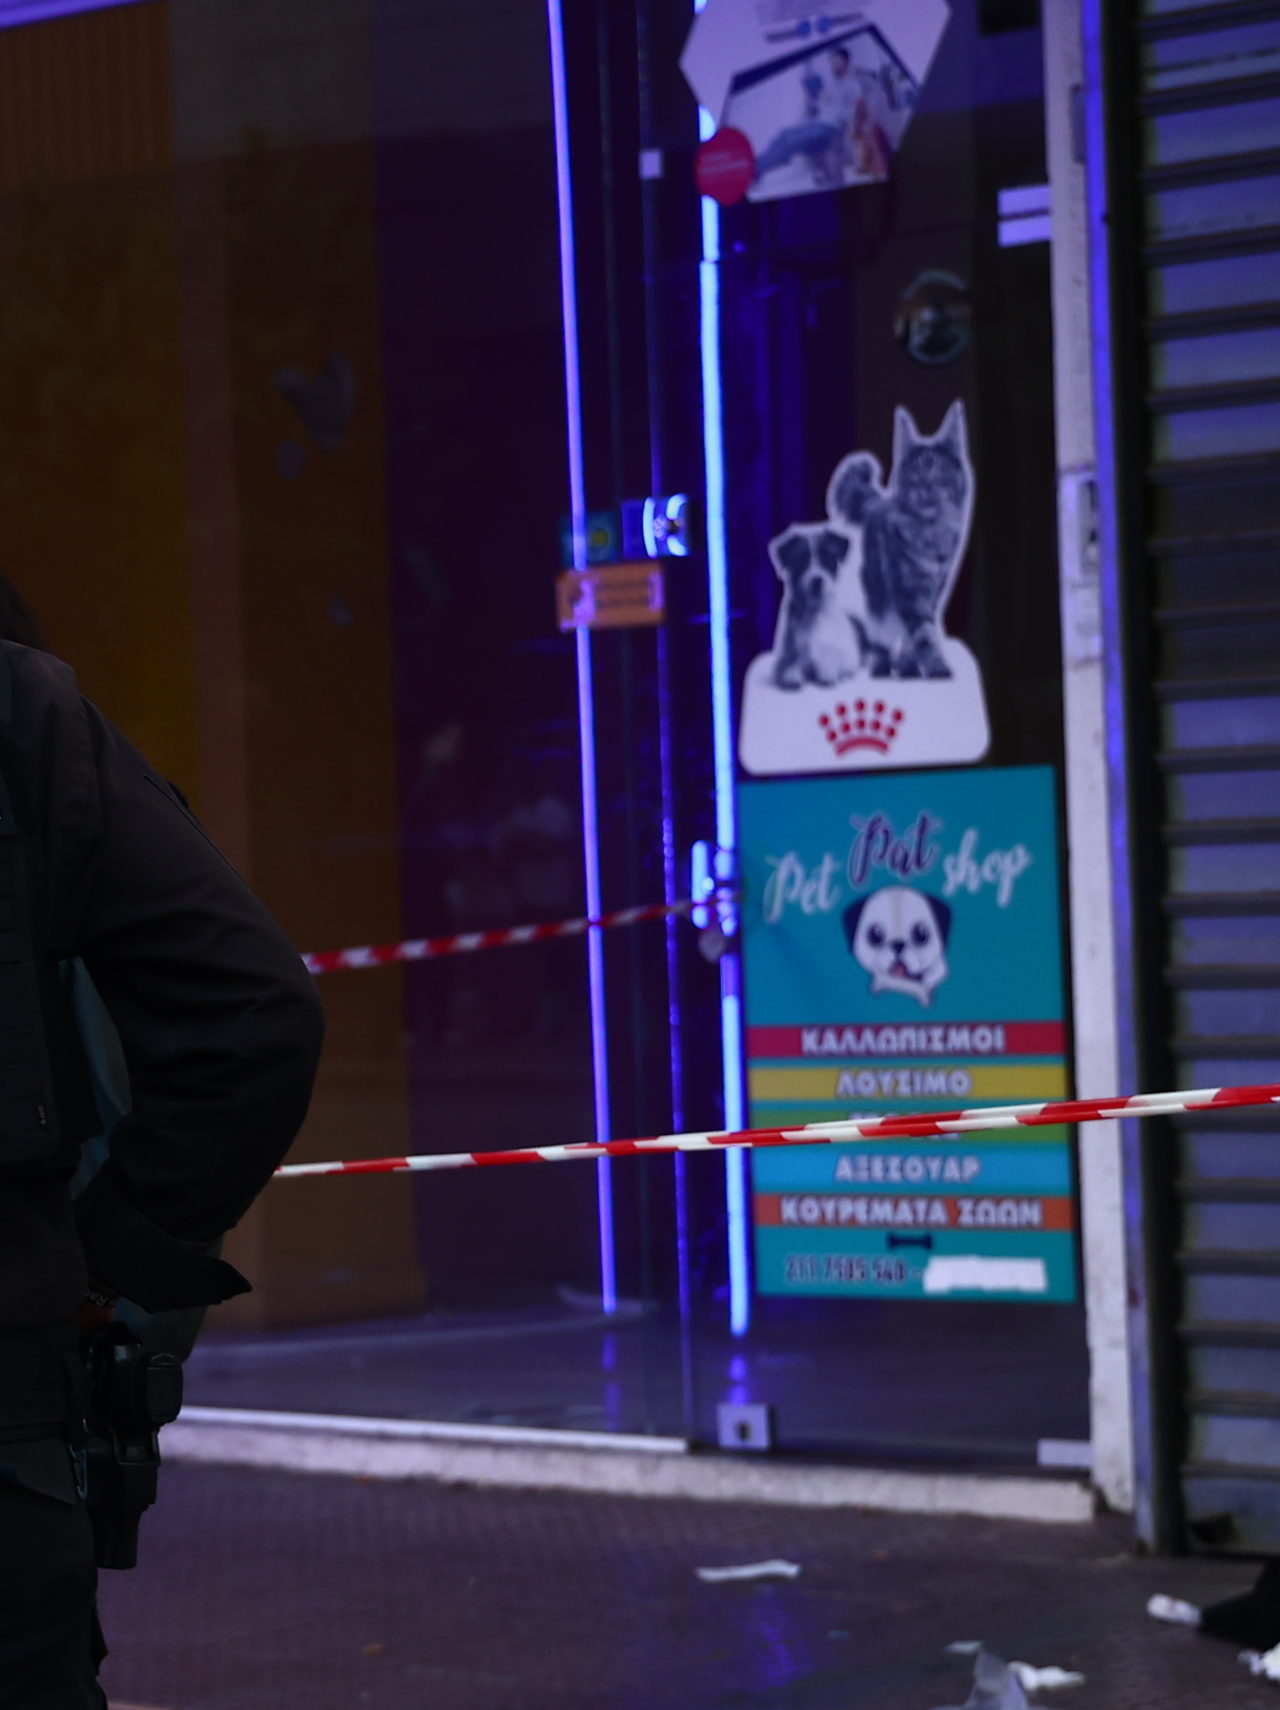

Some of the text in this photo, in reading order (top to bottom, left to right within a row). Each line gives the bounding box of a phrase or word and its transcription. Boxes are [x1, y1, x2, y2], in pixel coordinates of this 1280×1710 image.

[763, 851, 840, 923] Pet
[942, 828, 1033, 908] shop
[801, 1025, 1006, 1056] ΚΑΛΛΩΠΙΣΜΟΙ
[835, 1069, 972, 1098] ΛΟΥΣΙΜΟ
[834, 1155, 982, 1183] ΑΞΕΣΟΥΑΡ
[780, 1198, 1043, 1226] ΚΟΥΡΕΜΑΤΑ ΖΩΩΝ
